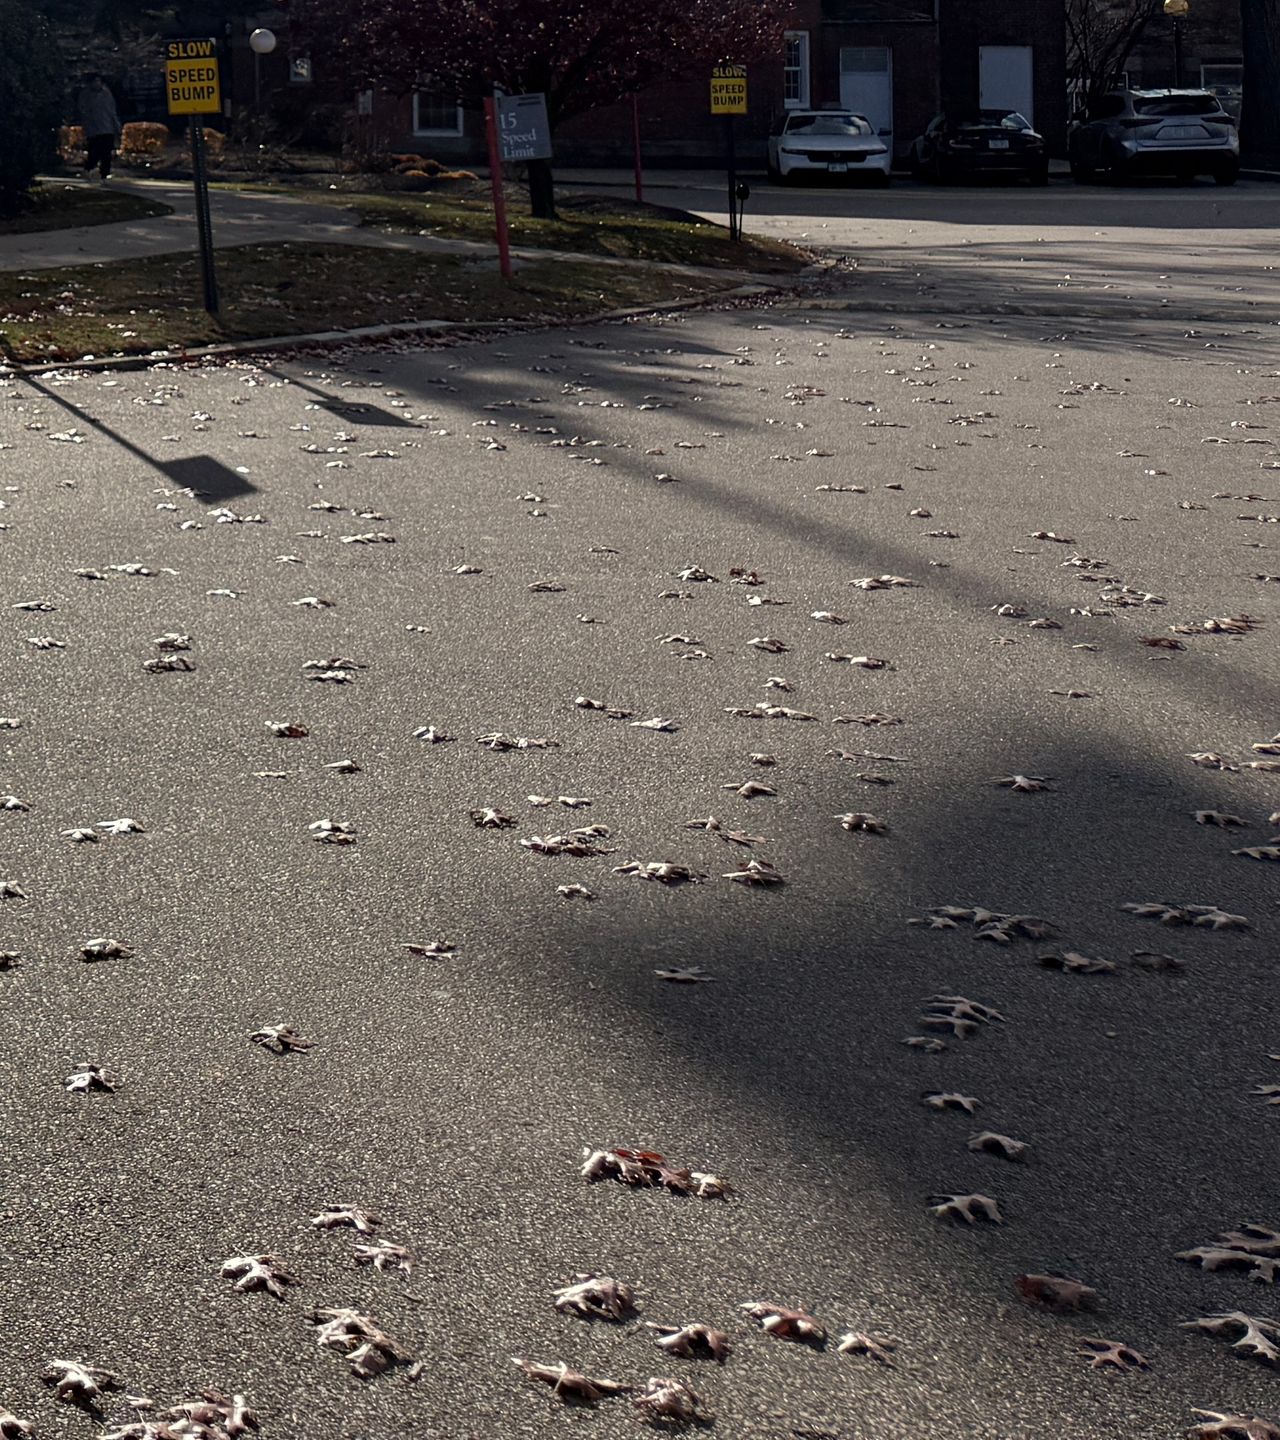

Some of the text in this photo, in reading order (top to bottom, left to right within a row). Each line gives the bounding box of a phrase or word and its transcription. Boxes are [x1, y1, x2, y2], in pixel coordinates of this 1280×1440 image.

[168, 41, 212, 58] SLOW
[169, 68, 215, 83] SPEED
[712, 66, 743, 77] SLOW
[171, 86, 215, 101] BUMP
[712, 84, 744, 94] SPEED
[713, 95, 744, 106] BUMP
[500, 112, 517, 129] 15
[501, 128, 537, 145] Speed
[503, 144, 536, 158] Limit
